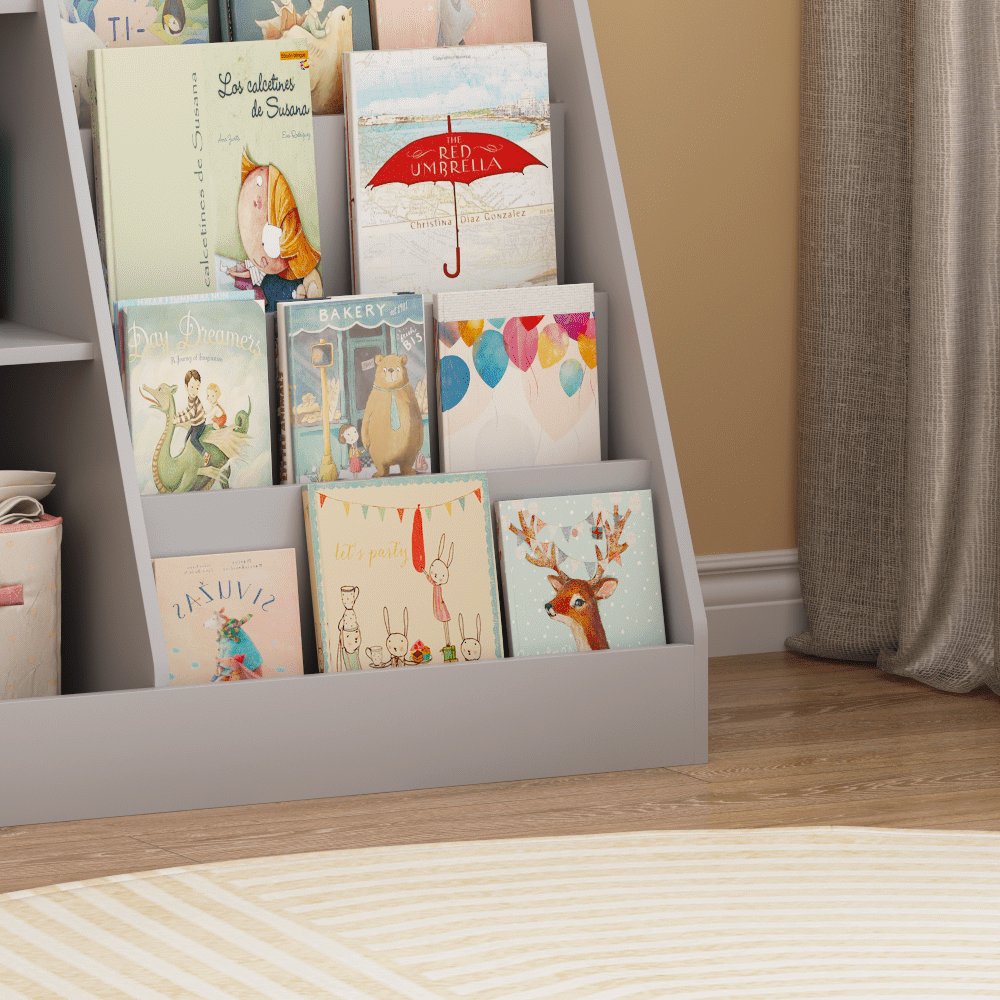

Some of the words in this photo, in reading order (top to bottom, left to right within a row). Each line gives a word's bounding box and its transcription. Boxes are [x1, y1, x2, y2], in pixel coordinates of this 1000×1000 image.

[108, 16, 145, 41] TI-
[218, 72, 244, 98] Los
[247, 72, 296, 93] calcetines
[191, 71, 203, 152] Susana
[251, 98, 263, 118] de
[265, 96, 310, 118] Susana
[438, 144, 471, 159] RED
[446, 136, 461, 144] THE
[193, 159, 204, 182] de
[410, 157, 502, 177] UMBRELLA
[199, 188, 210, 288] calcetines
[318, 303, 387, 322] BAKERY
[128, 320, 170, 361] Day
[177, 311, 262, 356] Dreamers
[367, 542, 409, 568] party
